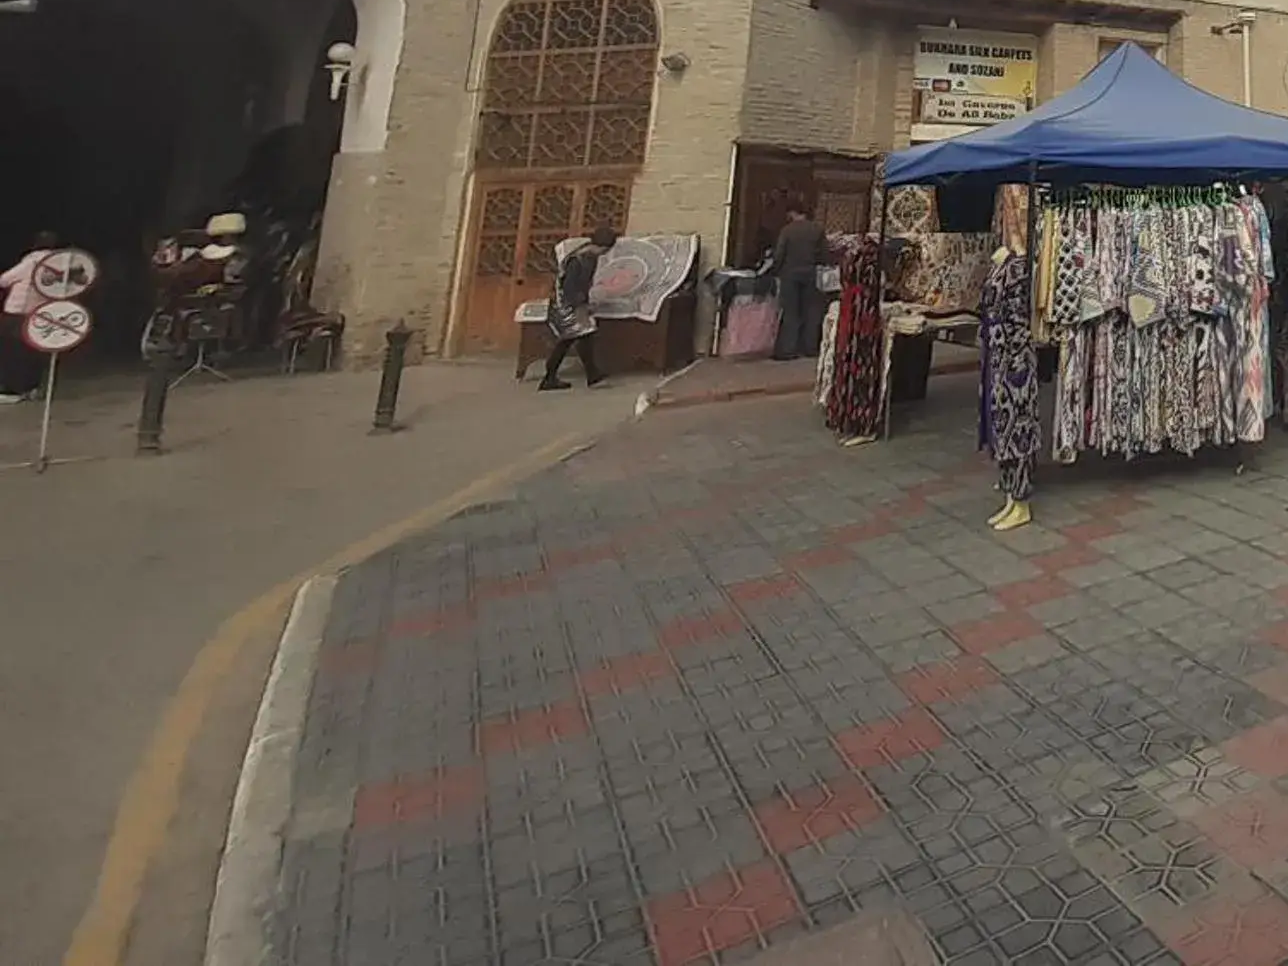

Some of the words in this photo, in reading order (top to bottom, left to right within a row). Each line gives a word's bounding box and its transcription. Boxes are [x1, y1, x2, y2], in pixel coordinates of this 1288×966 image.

[920, 41, 966, 56] BUKHARA
[968, 44, 990, 58] SILK
[992, 46, 1033, 60] CARPETS
[948, 62, 969, 75] AND
